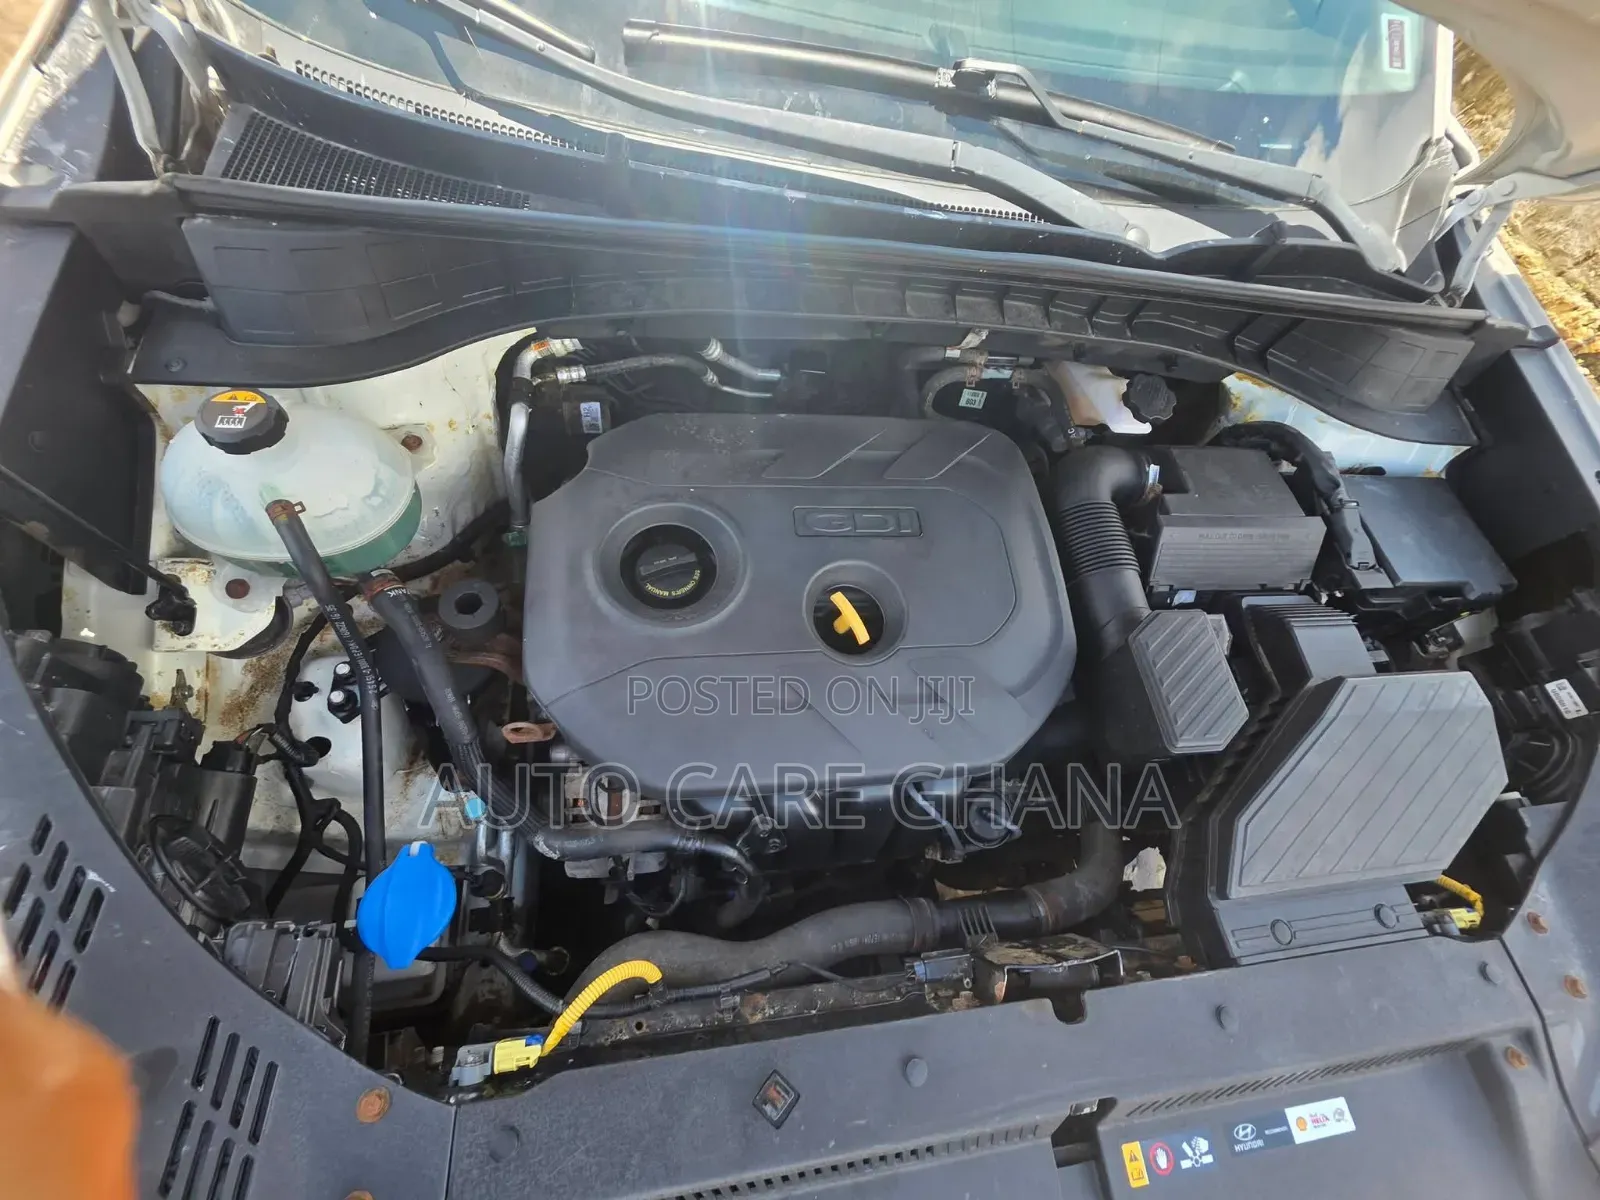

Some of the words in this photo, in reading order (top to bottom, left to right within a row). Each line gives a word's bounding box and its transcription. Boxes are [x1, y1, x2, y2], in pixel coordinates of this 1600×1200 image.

[805, 511, 912, 533] GDI
[645, 583, 669, 597] MANUAL
[1234, 1139, 1265, 1153] HYUNDAI
